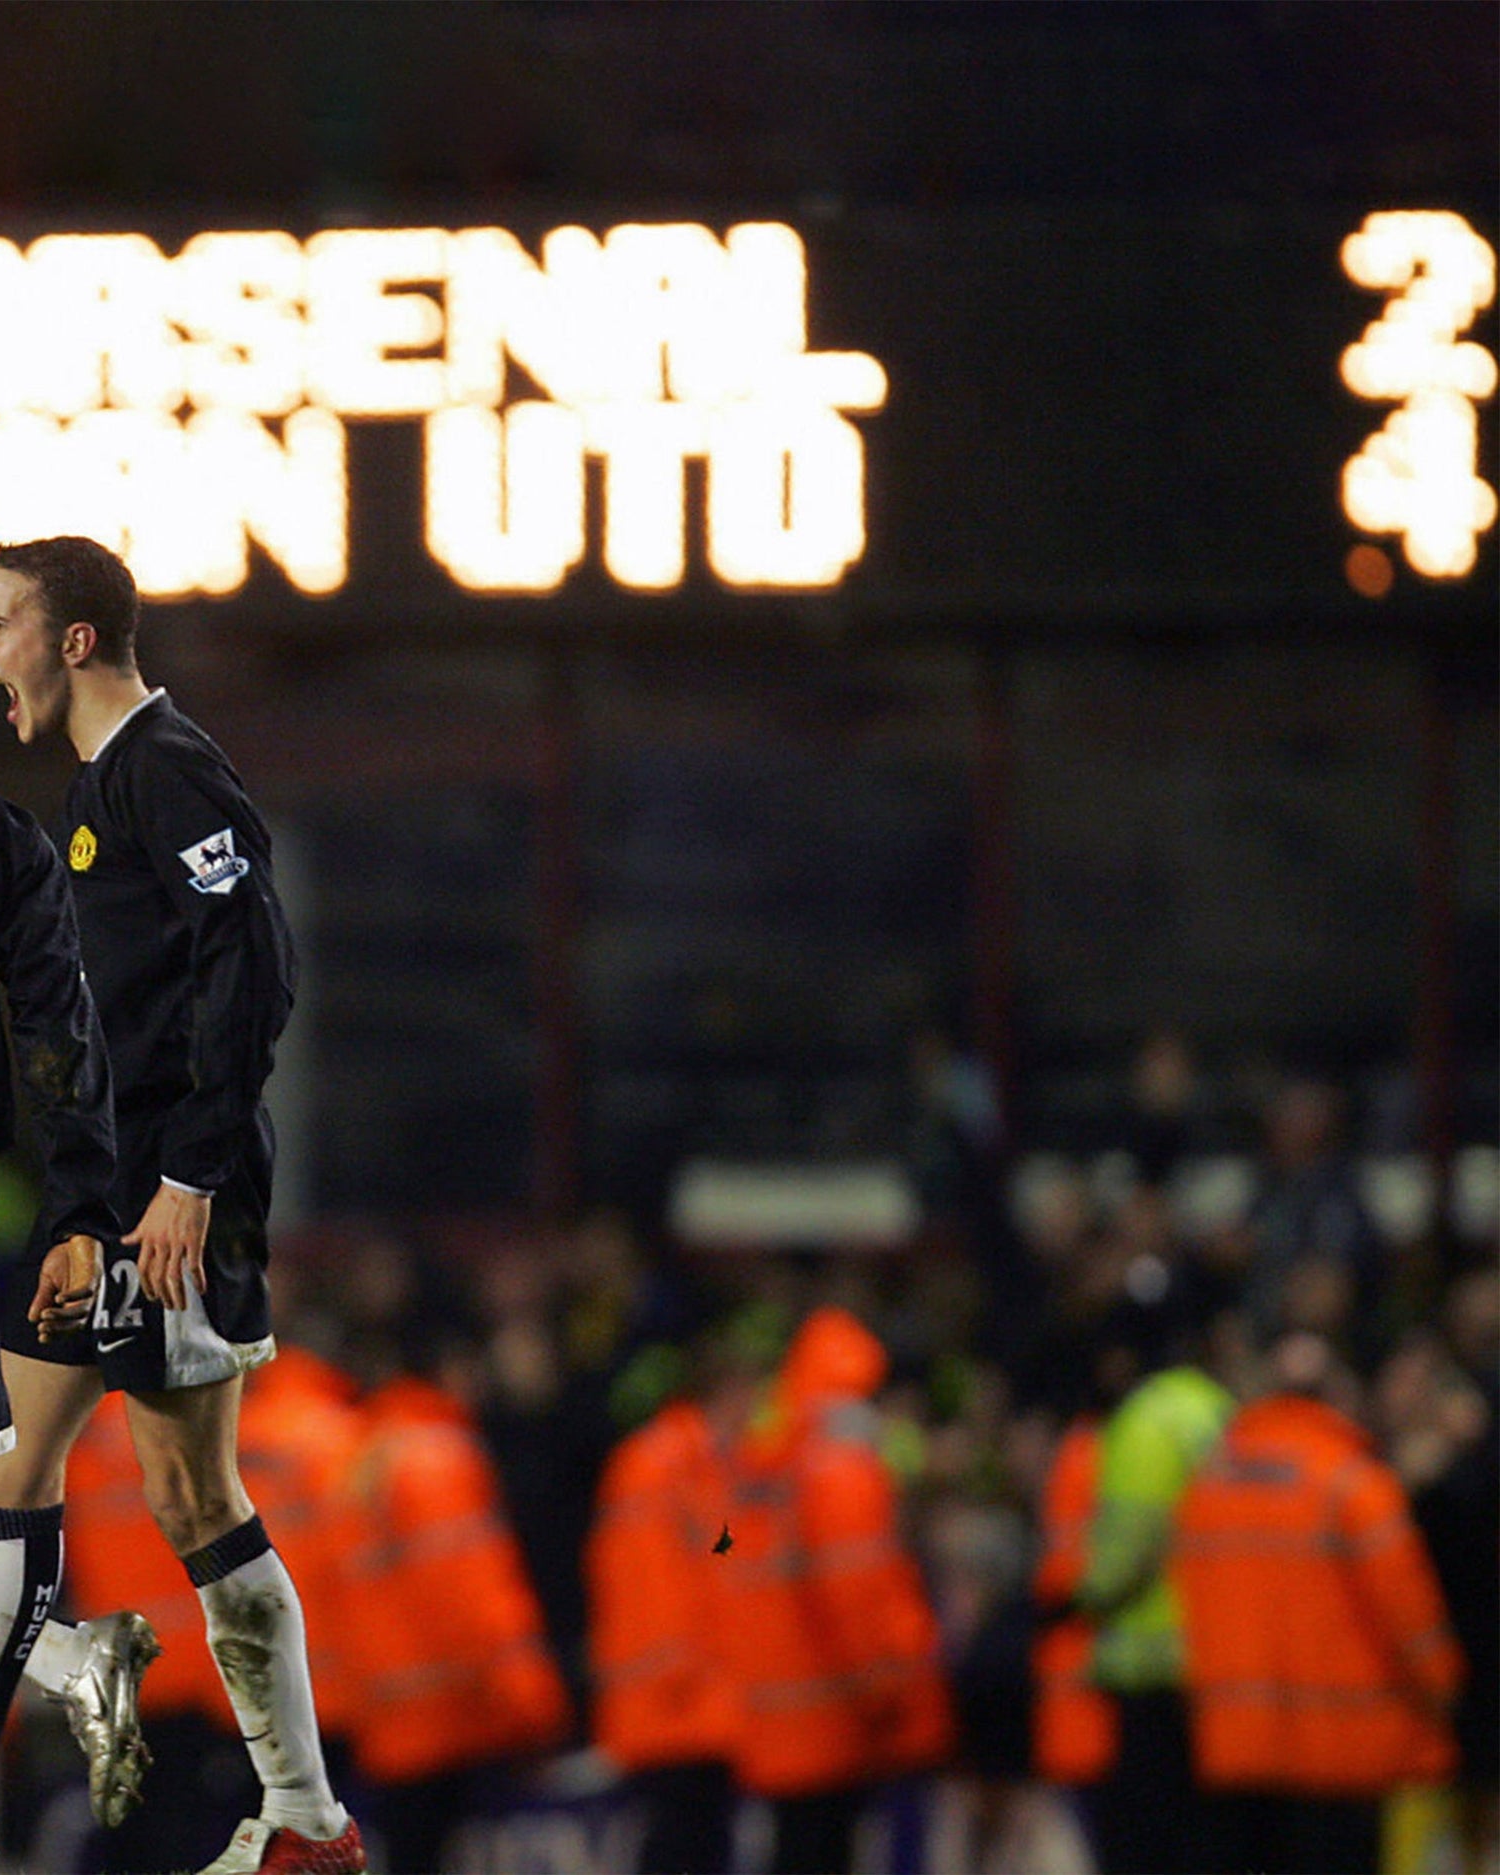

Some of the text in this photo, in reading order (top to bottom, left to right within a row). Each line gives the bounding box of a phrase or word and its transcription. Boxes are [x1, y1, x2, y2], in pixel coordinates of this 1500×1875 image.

[1340, 210, 1498, 399] 2
[425, 402, 866, 588] UTD
[1342, 393, 1498, 577] 4
[14, 1585, 54, 1660] MUFC
